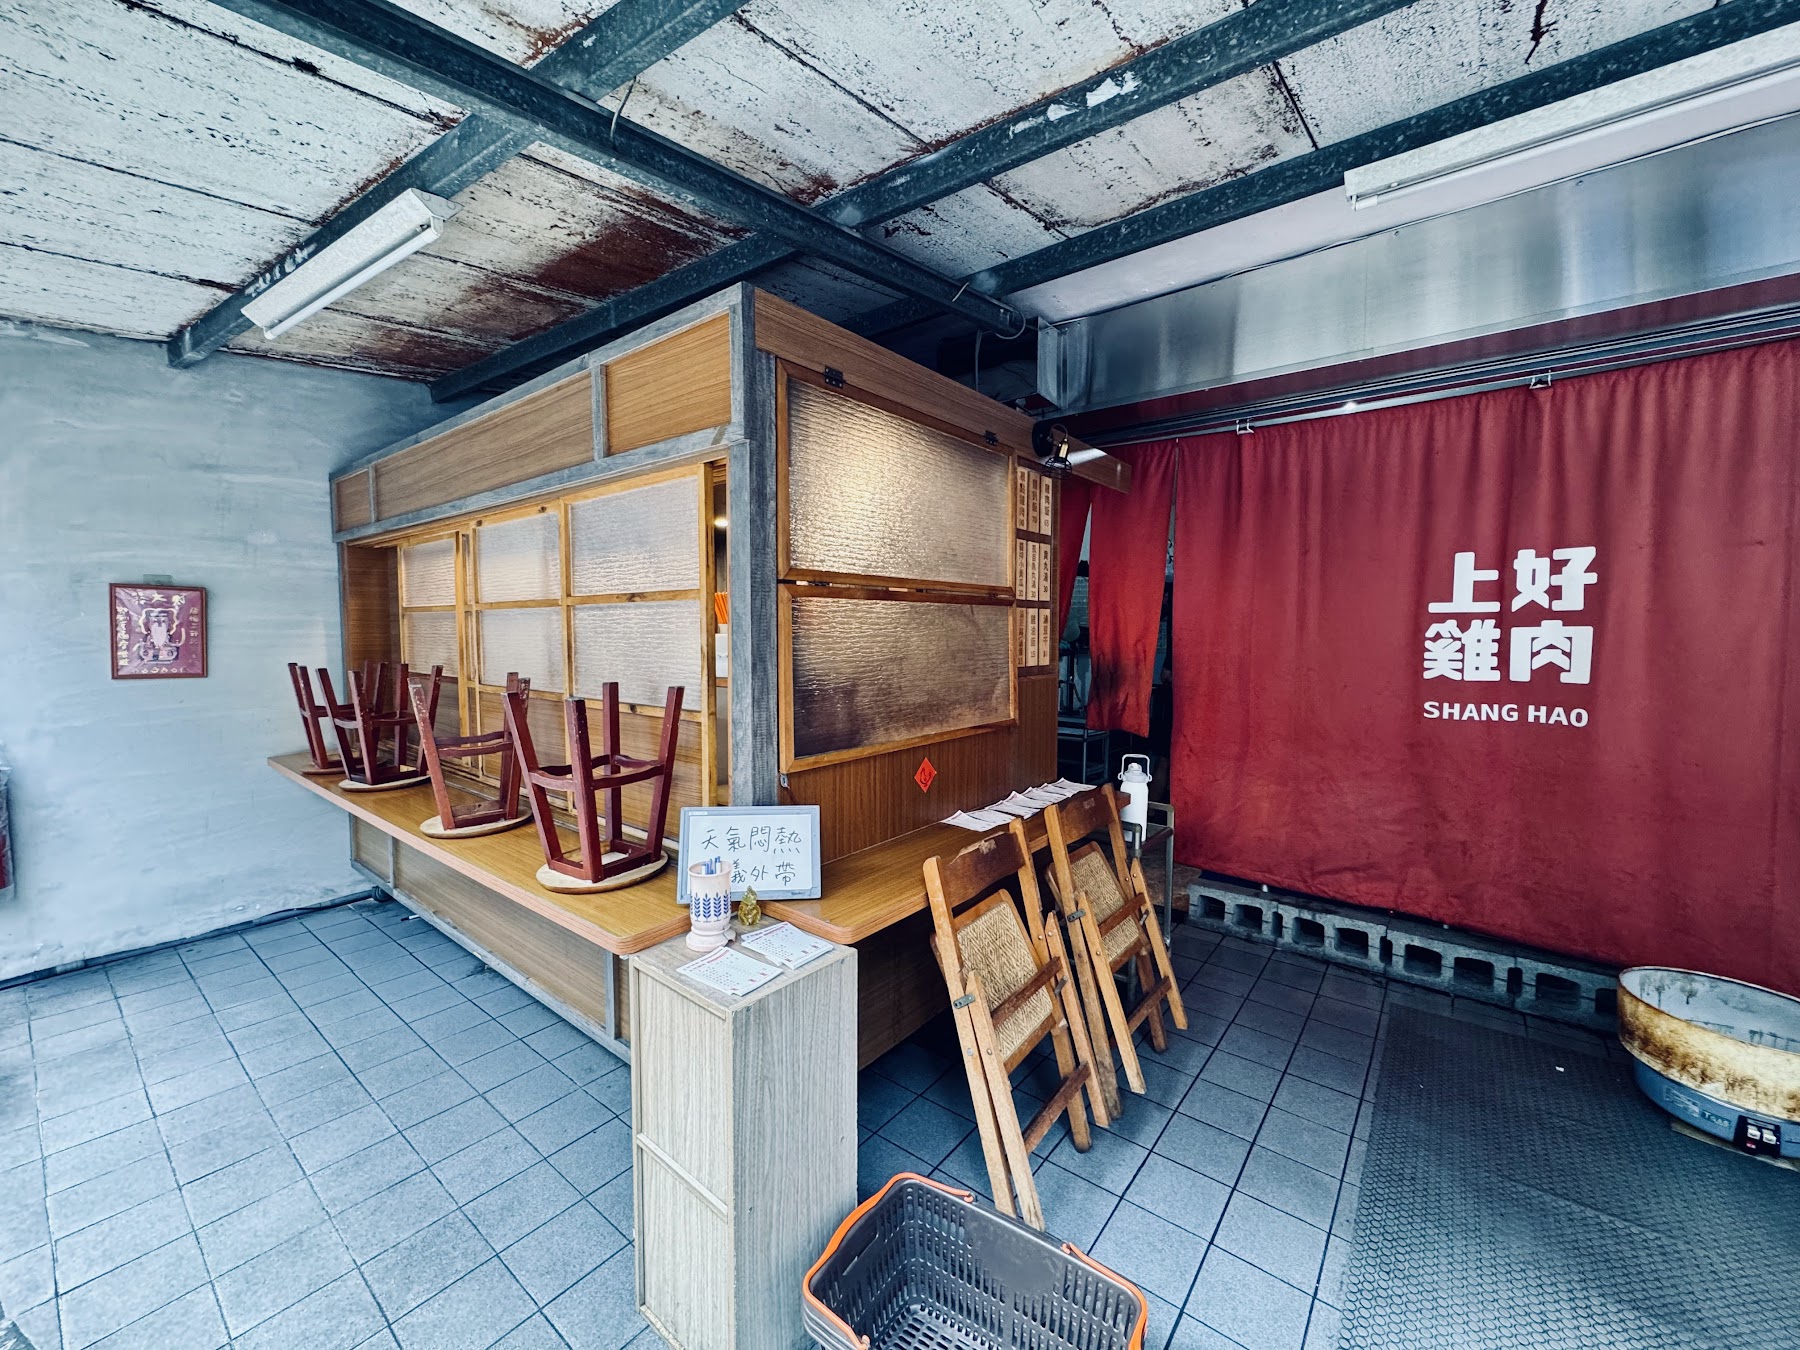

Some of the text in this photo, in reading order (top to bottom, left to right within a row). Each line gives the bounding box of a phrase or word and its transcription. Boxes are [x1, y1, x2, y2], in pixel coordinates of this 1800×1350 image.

[1428, 546, 1598, 613] 上好
[1423, 619, 1594, 685] 雞肉
[1423, 701, 1589, 728] SHANG HAO
[701, 825, 803, 855] 天氣悶熱
